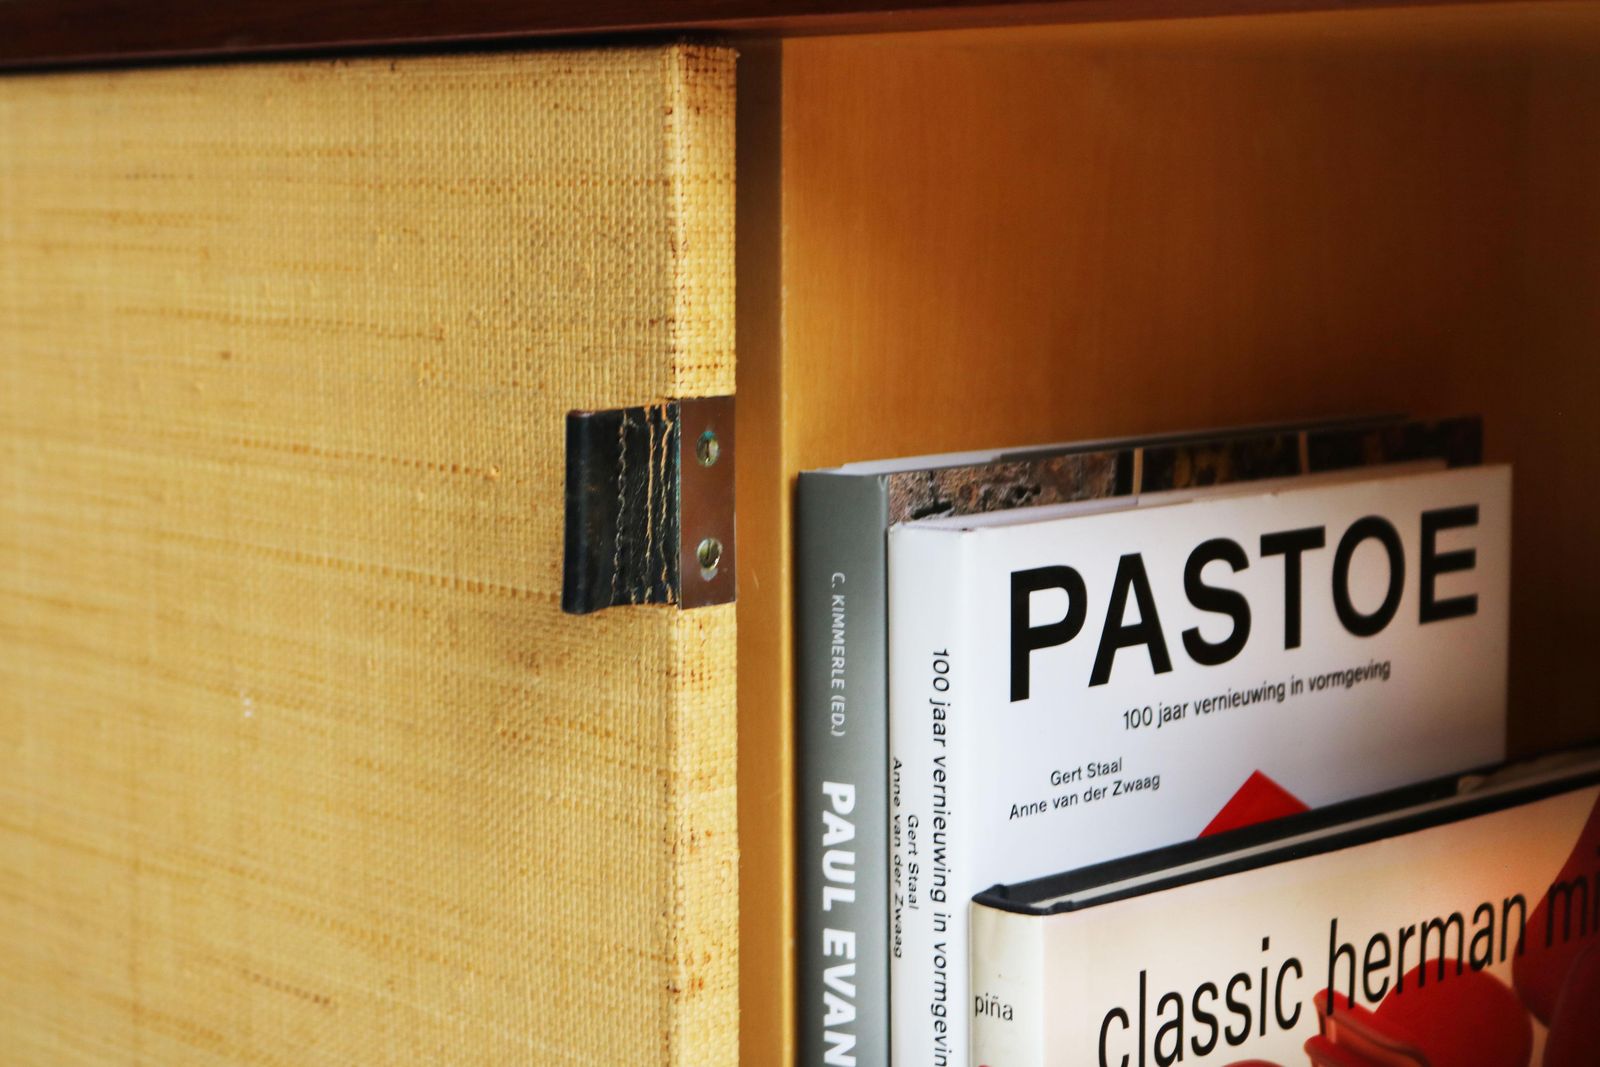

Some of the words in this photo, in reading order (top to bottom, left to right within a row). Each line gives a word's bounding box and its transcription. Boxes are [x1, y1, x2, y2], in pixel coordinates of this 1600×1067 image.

[831, 571, 846, 589] C.
[1009, 504, 1480, 703] PASTOE
[831, 594, 846, 690] KIMMERLE
[932, 648, 950, 692] 100
[1123, 705, 1153, 730] 100
[1157, 701, 1189, 728] jaar
[1194, 681, 1286, 715] vernieuwing
[1290, 675, 1304, 695] in
[1308, 658, 1392, 693] vormgeving
[830, 694, 846, 737] (ED.)
[929, 698, 951, 747] jaar
[893, 756, 903, 807] Anne
[1050, 766, 1082, 786] Gert
[1087, 756, 1123, 778] Staal
[1009, 800, 1047, 820] Anne
[1053, 792, 1078, 809] van
[1083, 786, 1108, 803] der
[1112, 774, 1161, 797] Zwaag
[822, 781, 856, 911] PAUL
[893, 814, 902, 848] van
[908, 814, 919, 855] Gert
[930, 756, 952, 903] vernieuwing
[893, 853, 904, 887] der
[908, 862, 919, 910] Staal
[893, 894, 904, 959] Zwaag
[934, 912, 952, 932] in
[822, 928, 857, 1067] EVAN
[1098, 935, 1304, 1067] classic
[1326, 891, 1527, 1017] herman
[974, 992, 1014, 1021] piña
